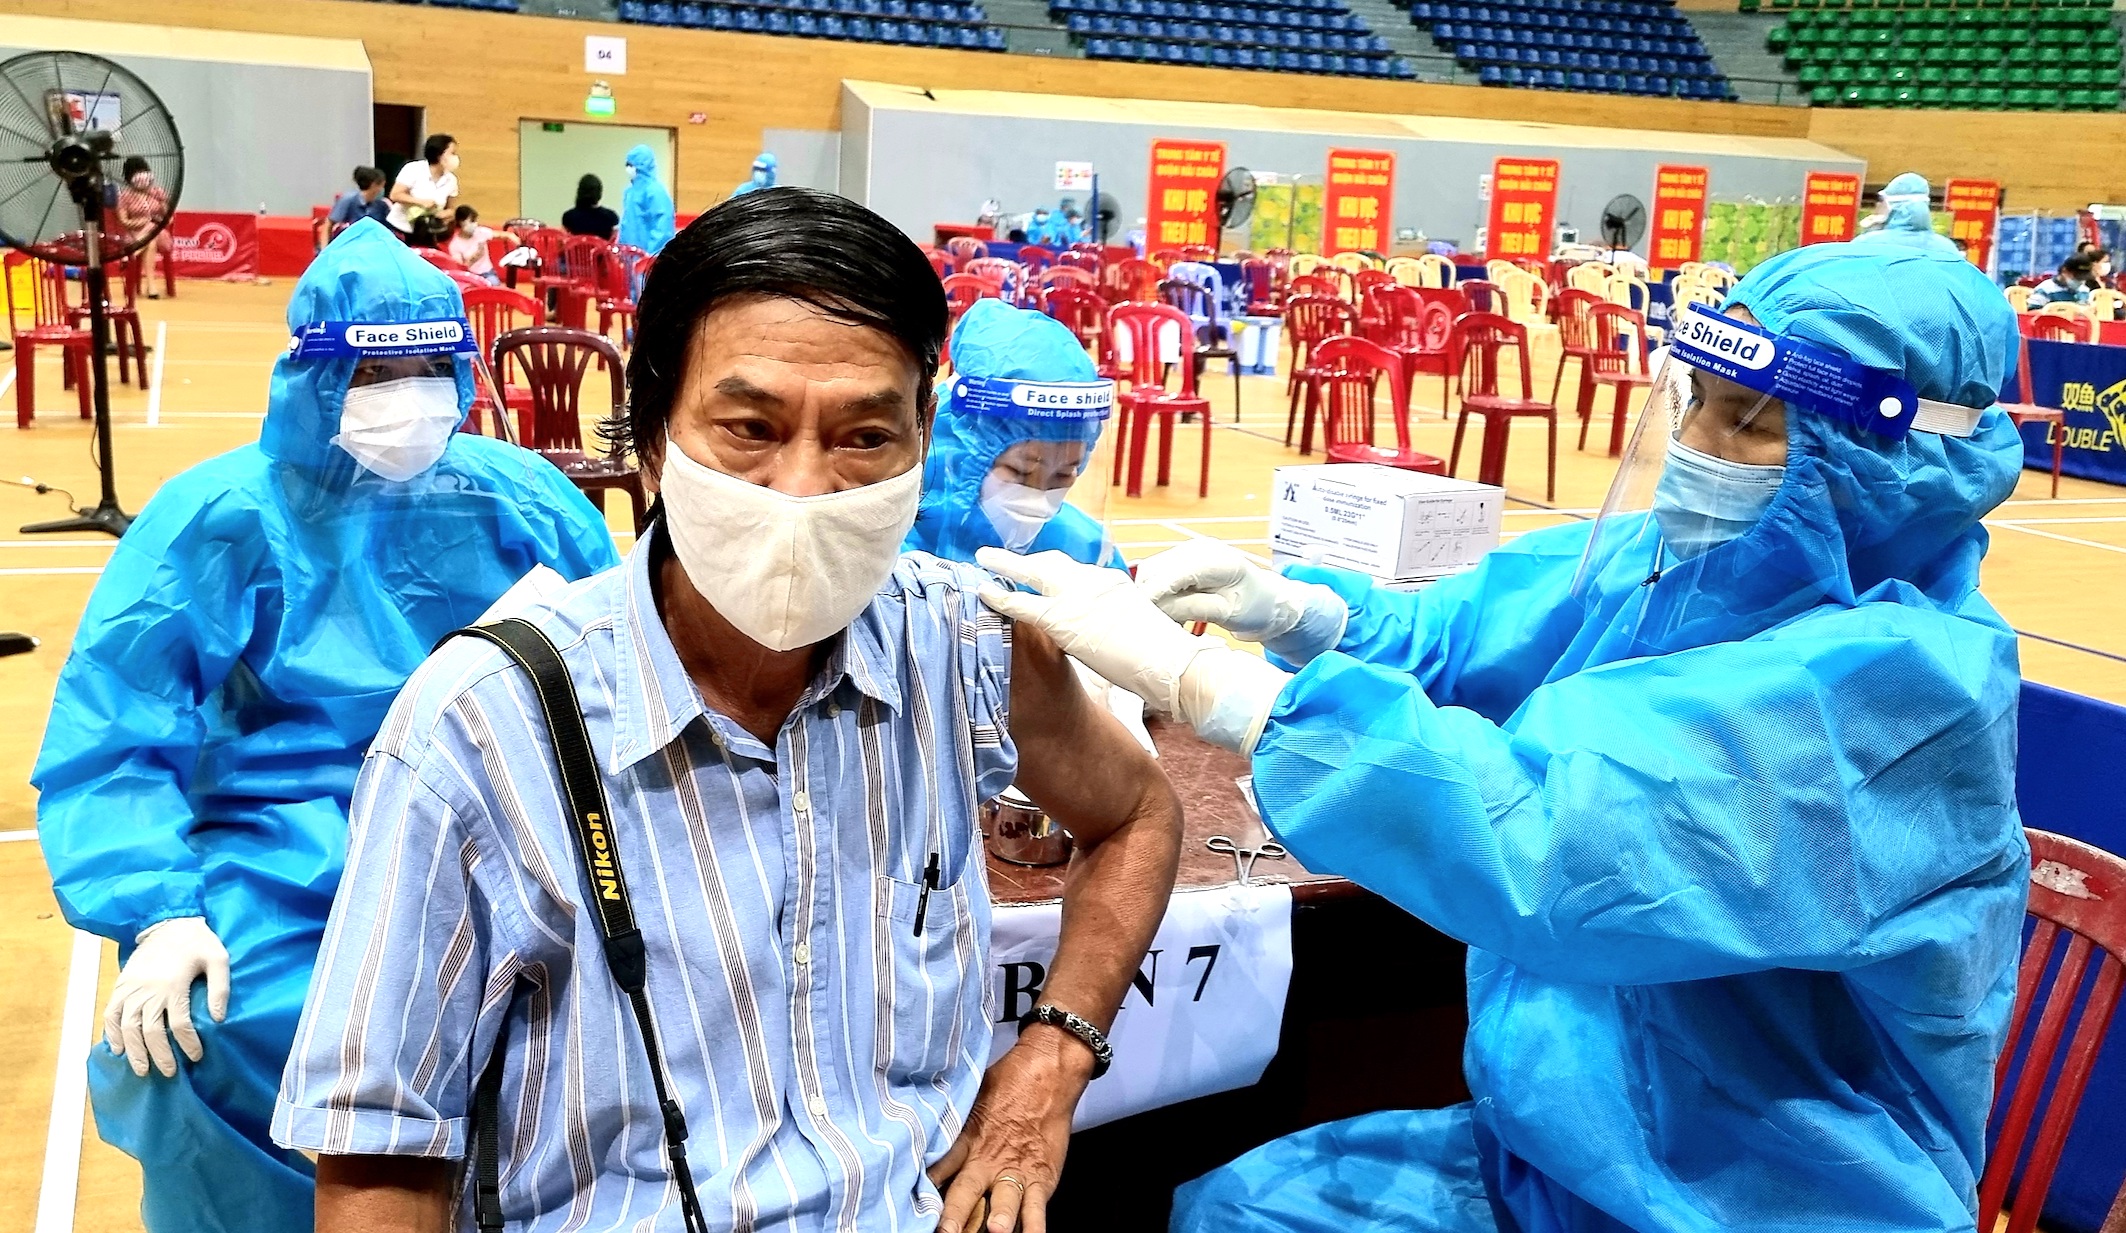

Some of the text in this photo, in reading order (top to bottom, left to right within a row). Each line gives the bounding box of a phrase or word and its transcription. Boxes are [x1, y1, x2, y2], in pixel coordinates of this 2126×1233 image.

[1163, 189, 1208, 217] KHU VỰC
[355, 330, 399, 343] Face
[405, 326, 457, 342] Shield
[1691, 322, 1760, 361] Shield
[362, 348, 403, 356] Protective
[405, 347, 438, 355] Isolation
[1681, 347, 1711, 367] Isolation
[1713, 362, 1738, 378] Mask
[1027, 390, 1068, 404] Face
[1076, 391, 1110, 404] shield
[1027, 408, 1054, 417] Direct
[1056, 410, 1082, 419] Splash
[2046, 421, 2114, 452] DOUBLE
[587, 813, 621, 900] Nikon
[996, 944, 1221, 1024] BN 7
